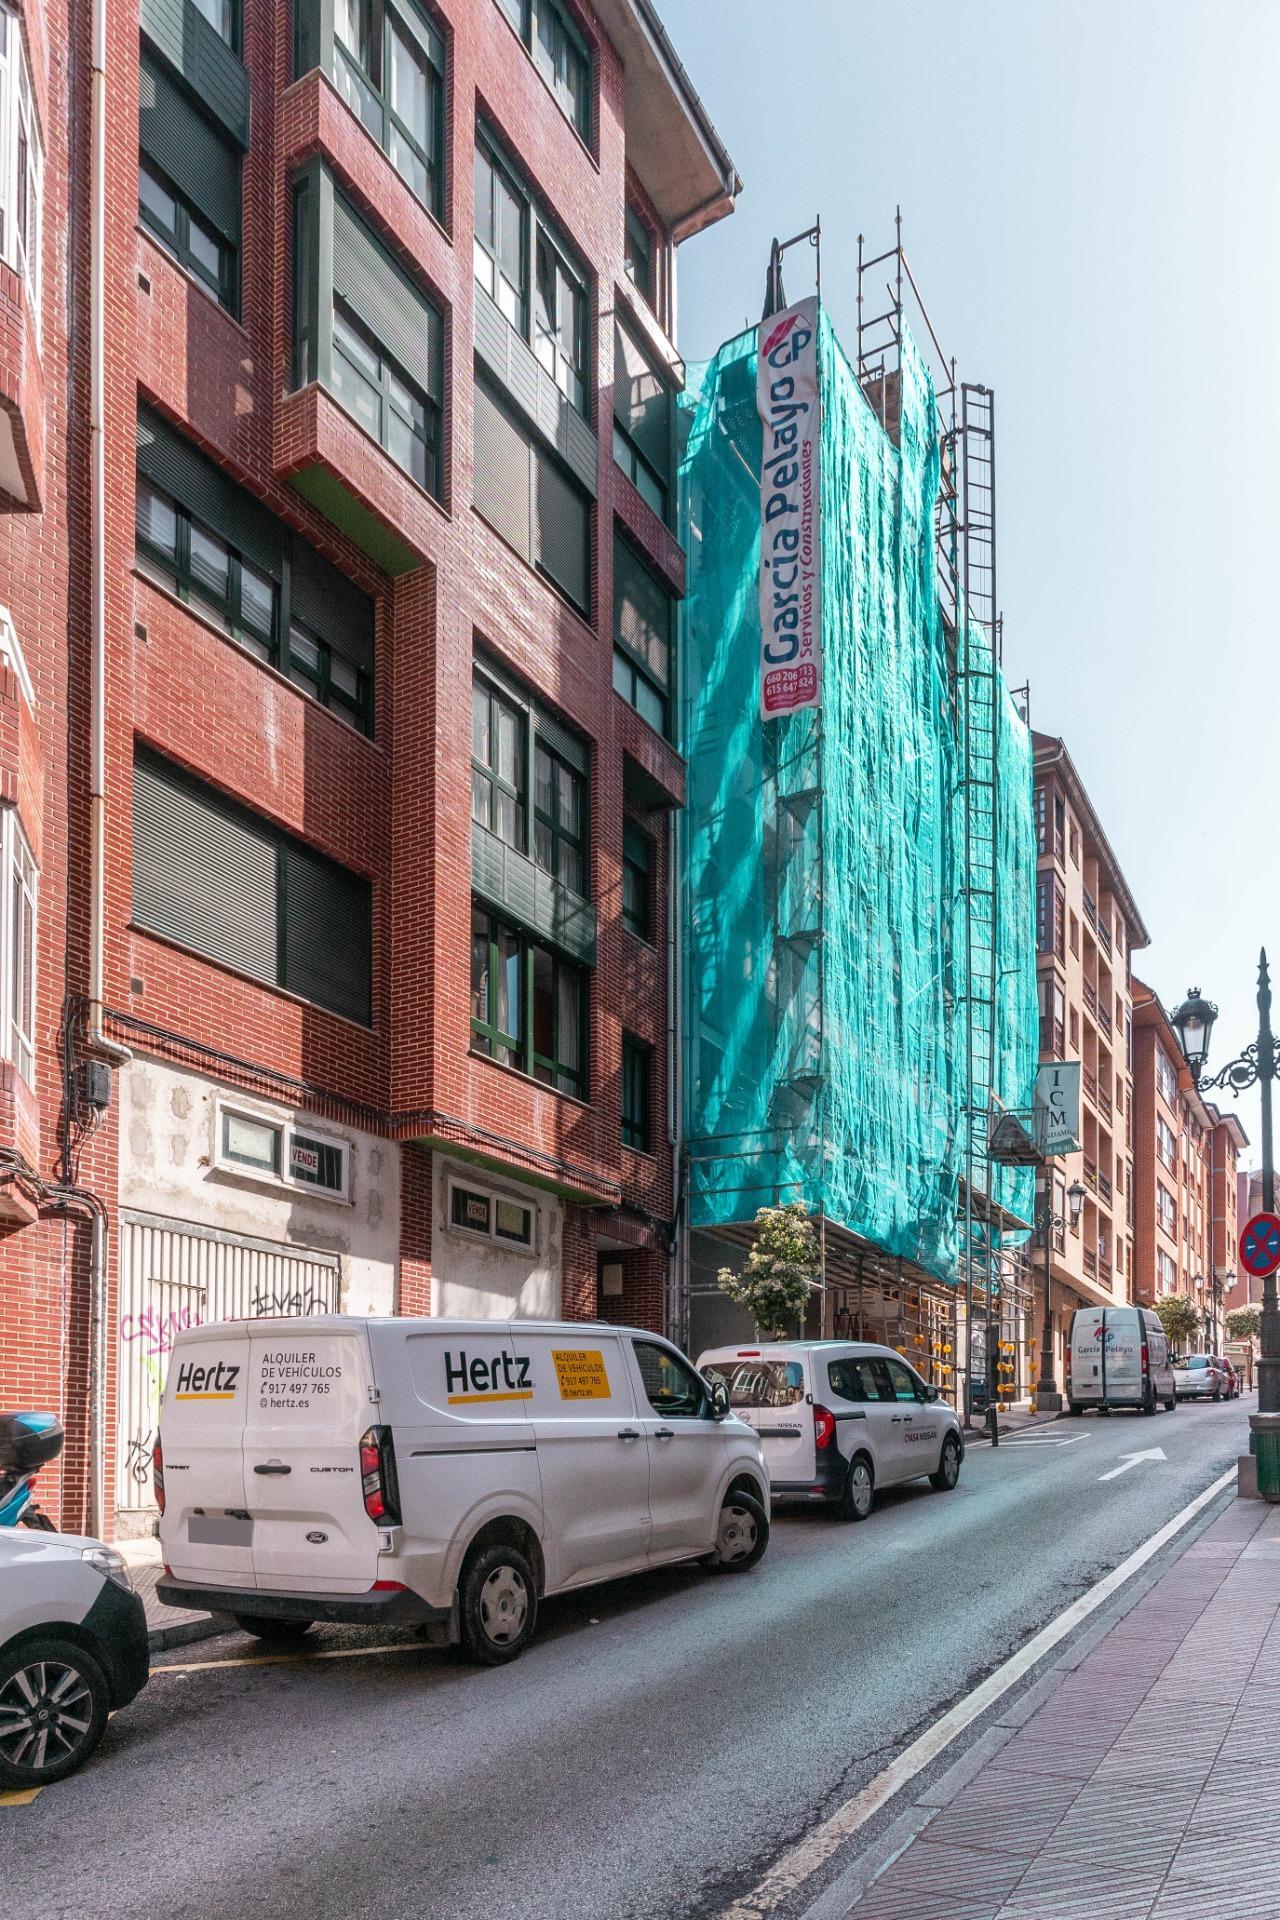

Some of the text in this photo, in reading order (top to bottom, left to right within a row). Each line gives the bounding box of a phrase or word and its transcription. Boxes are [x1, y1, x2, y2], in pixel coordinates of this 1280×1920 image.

[768, 330, 812, 368] GP
[764, 376, 809, 524] Pelayo
[800, 439, 815, 658] Servicios y Construcciones
[766, 672, 781, 685] 660
[782, 671, 798, 681] 206
[766, 683, 781, 696] 615
[783, 681, 797, 692] 647
[292, 1148, 317, 1168] VENDE
[469, 1202, 487, 1218] VENDE
[556, 1352, 587, 1361] ALQUILER
[1105, 1345, 1133, 1354] Pelayo
[262, 1353, 316, 1365] ALQUILER
[261, 1364, 342, 1378] DE VEHÍCULOS
[444, 1351, 532, 1392] Hertz
[558, 1363, 568, 1372] DE
[176, 1361, 240, 1392] Hertz
[566, 1376, 577, 1386] 917
[268, 1384, 330, 1394] 917 497 765
[270, 1398, 310, 1408] hertz.es
